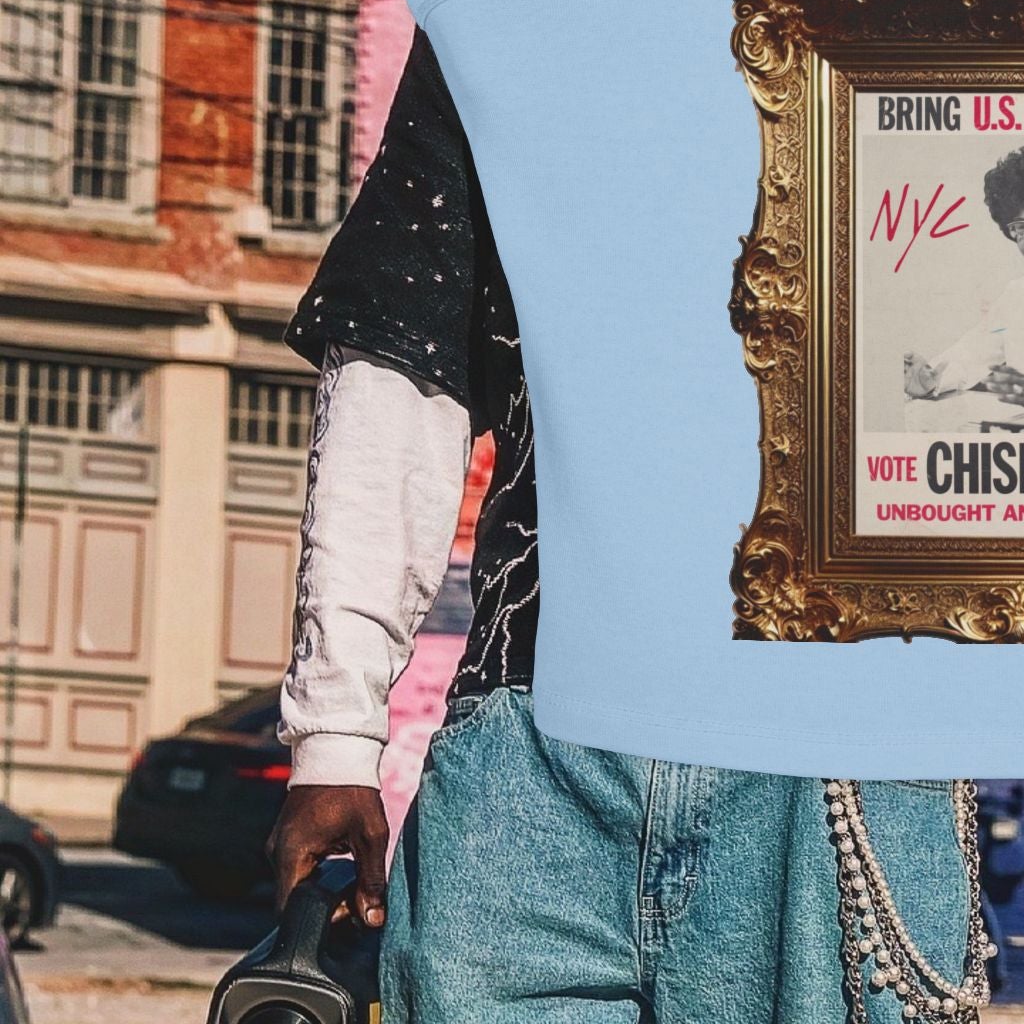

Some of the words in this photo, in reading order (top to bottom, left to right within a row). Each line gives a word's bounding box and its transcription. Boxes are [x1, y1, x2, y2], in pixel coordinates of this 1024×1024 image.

[878, 95, 961, 131] BRING
[973, 95, 1023, 131] U.S.
[869, 183, 970, 274] NYC
[867, 456, 918, 482] VOTE
[877, 504, 996, 522] UNBOUGHT
